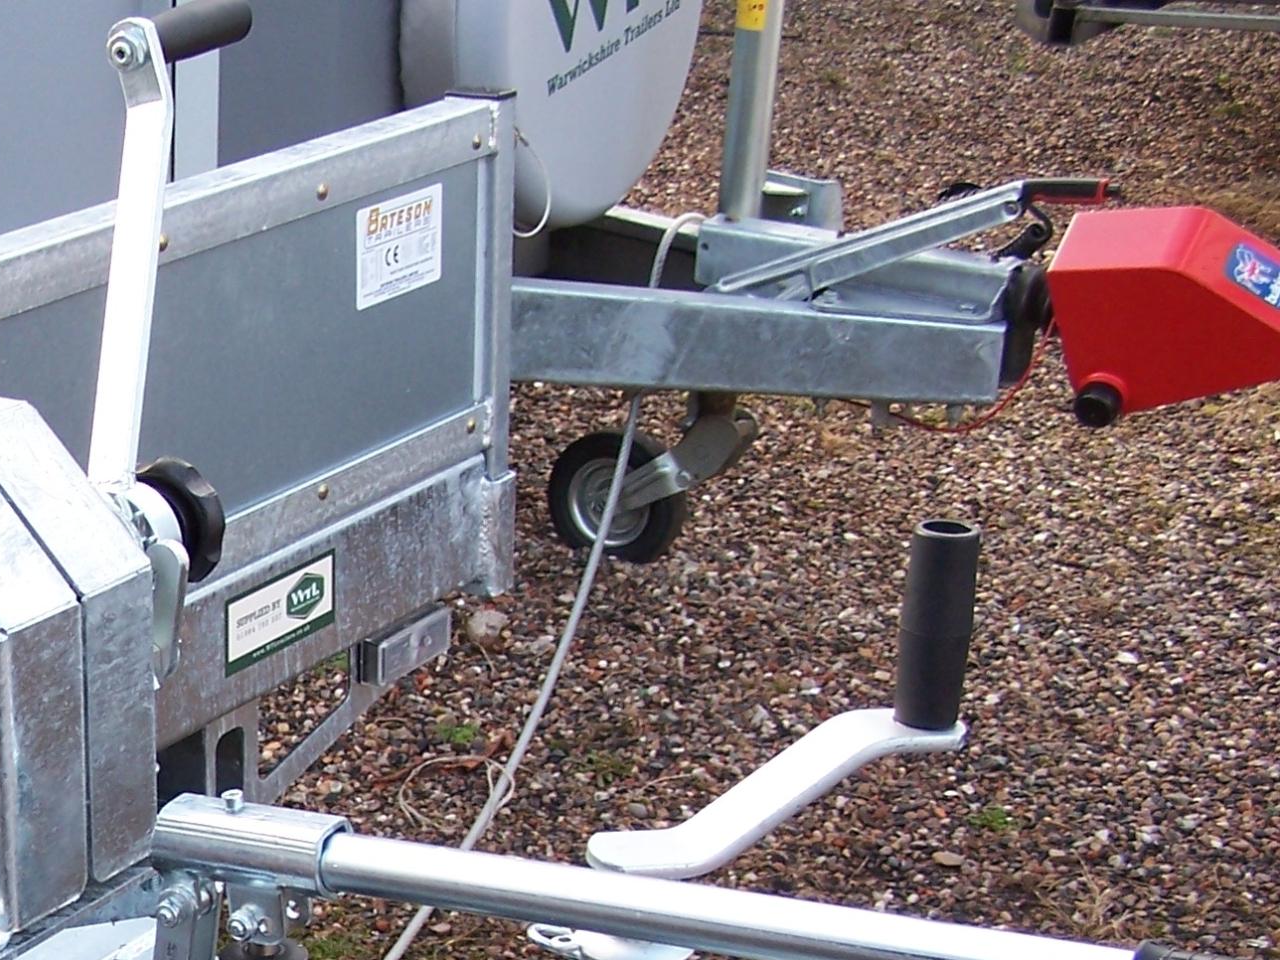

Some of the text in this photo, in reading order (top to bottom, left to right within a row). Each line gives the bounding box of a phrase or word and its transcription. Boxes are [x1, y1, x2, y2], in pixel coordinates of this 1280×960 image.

[546, 0, 680, 97] Warwickshire Trailers Ltd
[367, 199, 433, 237] BATESON
[291, 582, 320, 606] WTL
